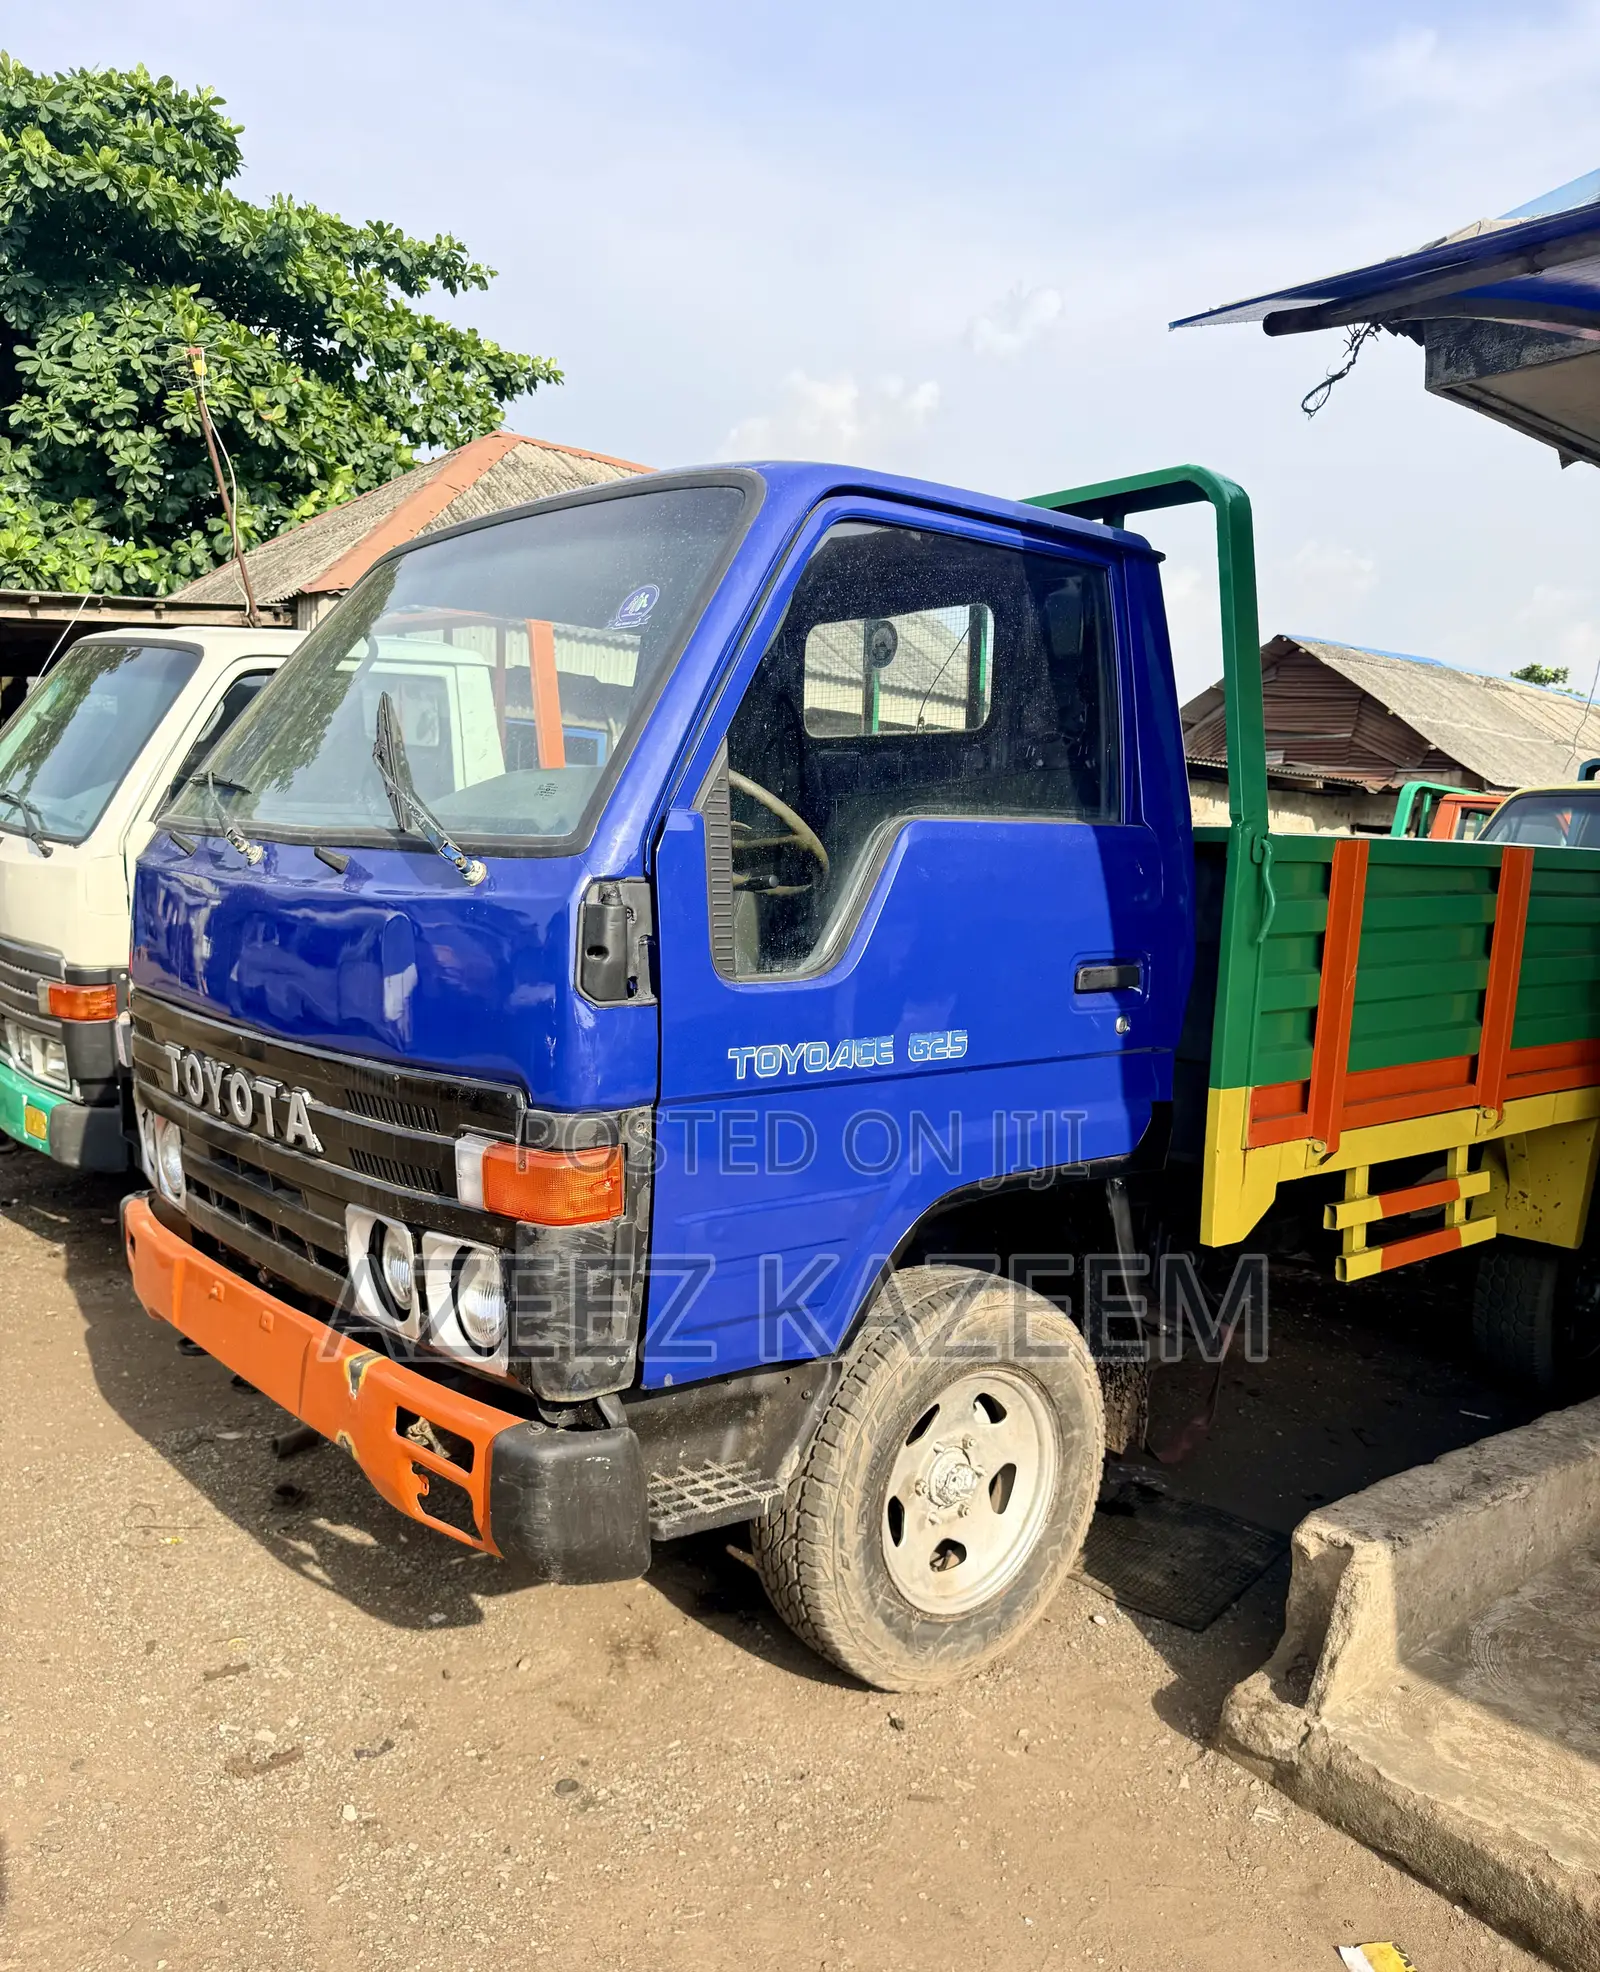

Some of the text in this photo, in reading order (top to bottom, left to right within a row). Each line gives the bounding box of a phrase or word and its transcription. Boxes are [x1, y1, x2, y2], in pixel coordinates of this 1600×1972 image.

[728, 1029, 968, 1080] TOYOACE G25
[164, 1041, 324, 1153] TOYOTA
